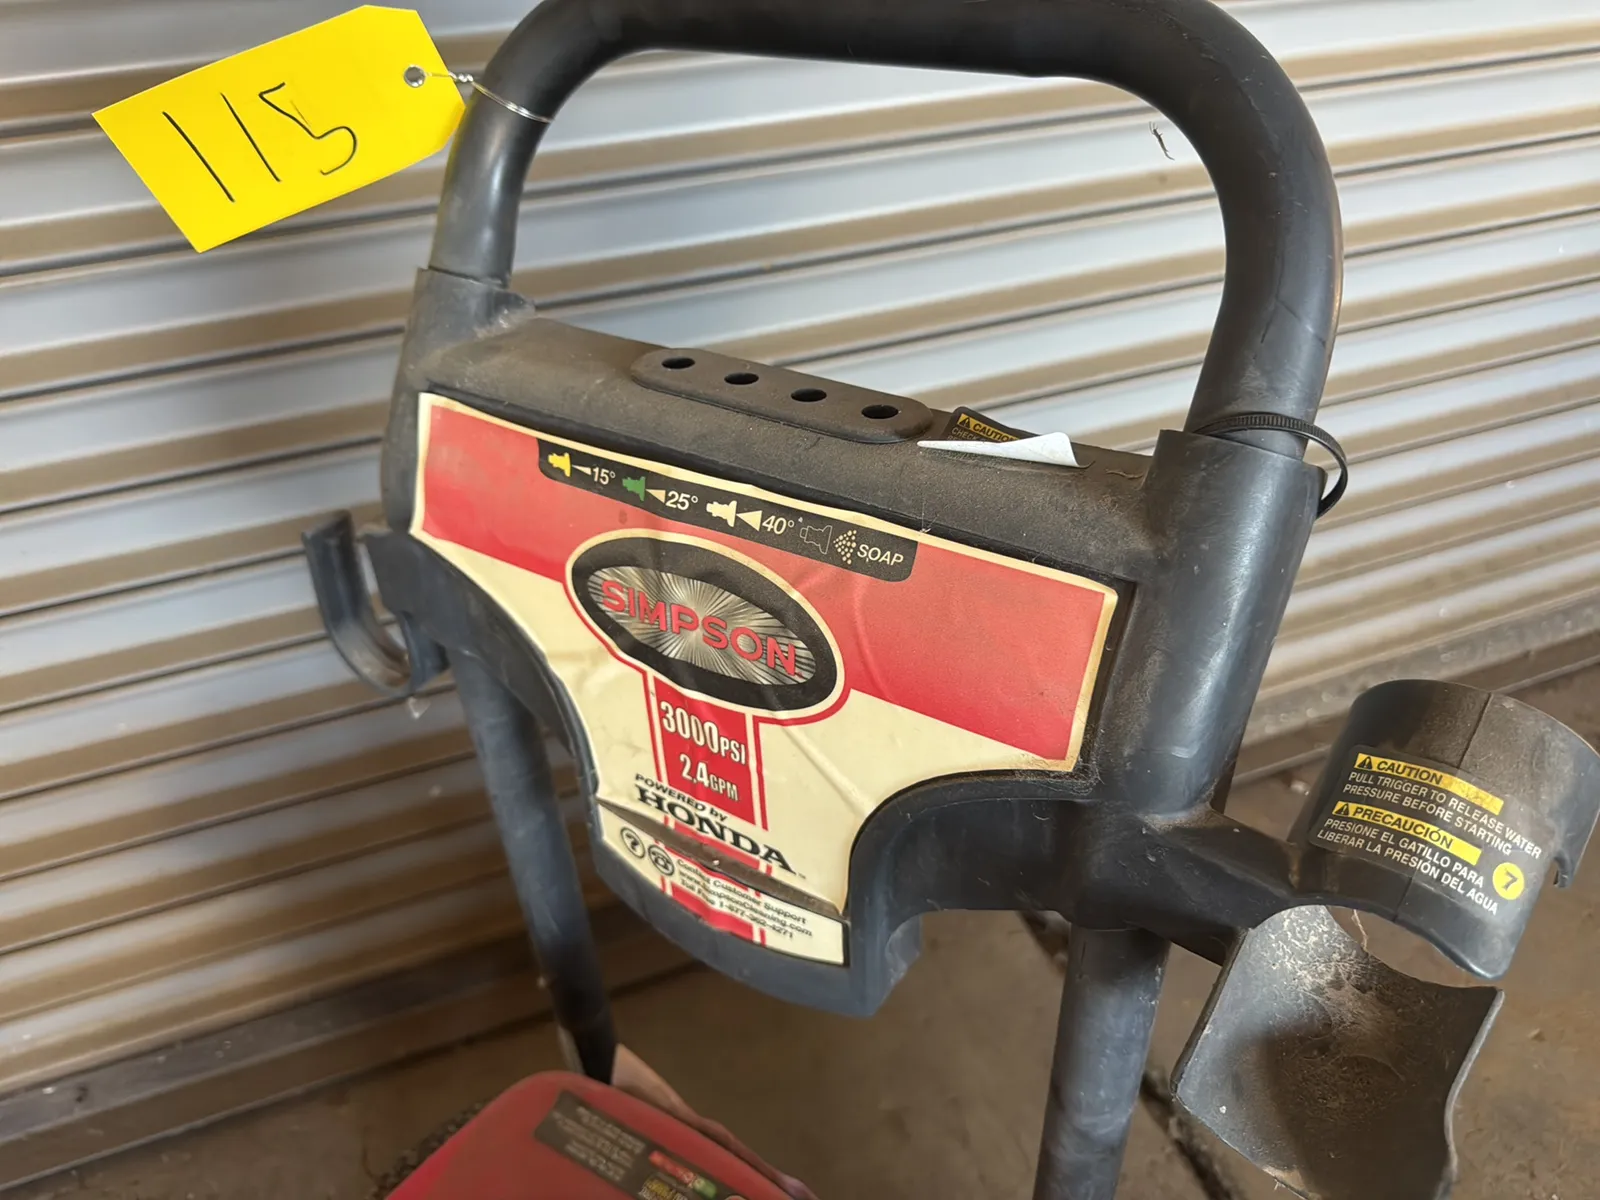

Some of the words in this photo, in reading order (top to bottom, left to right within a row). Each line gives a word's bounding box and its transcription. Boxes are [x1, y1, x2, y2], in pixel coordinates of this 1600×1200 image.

[162, 82, 357, 202] 115
[591, 466, 616, 485] 15°
[665, 490, 698, 511] 25°
[762, 514, 795, 535] 40°
[857, 544, 904, 566] SOAP
[600, 580, 797, 676] SIMPSON
[635, 773, 707, 812] POWERED
[710, 806, 728, 821] by
[1376, 760, 1444, 785] CAUTION
[635, 784, 797, 875] HONDA
[1342, 784, 1400, 804] PRESSURE
[1401, 795, 1453, 823] BEFORE
[1454, 817, 1512, 856] STARTING
[1348, 771, 1374, 785] PULL
[1376, 775, 1428, 798] TRIGGER
[1430, 788, 1447, 803] TO
[1448, 797, 1503, 833] RELEASE
[1504, 825, 1542, 860] WATER
[1352, 806, 1453, 850] PRECAUCIÓN
[1316, 829, 1364, 850] LIBERAR
[1365, 841, 1382, 855] LA
[1384, 846, 1441, 880] PRESIÓN
[1440, 871, 1465, 895] DEL
[1465, 887, 1500, 916] AGUA
[1323, 818, 1378, 839] PRESIONE
[1380, 831, 1395, 846] EL
[1399, 836, 1452, 867] GATILLO
[1452, 861, 1485, 888] PARA
[1499, 868, 1518, 892] 7
[678, 869, 813, 937] www.mpsonCleaning.com
[713, 880, 761, 906] Customer
[763, 902, 807, 924] Support
